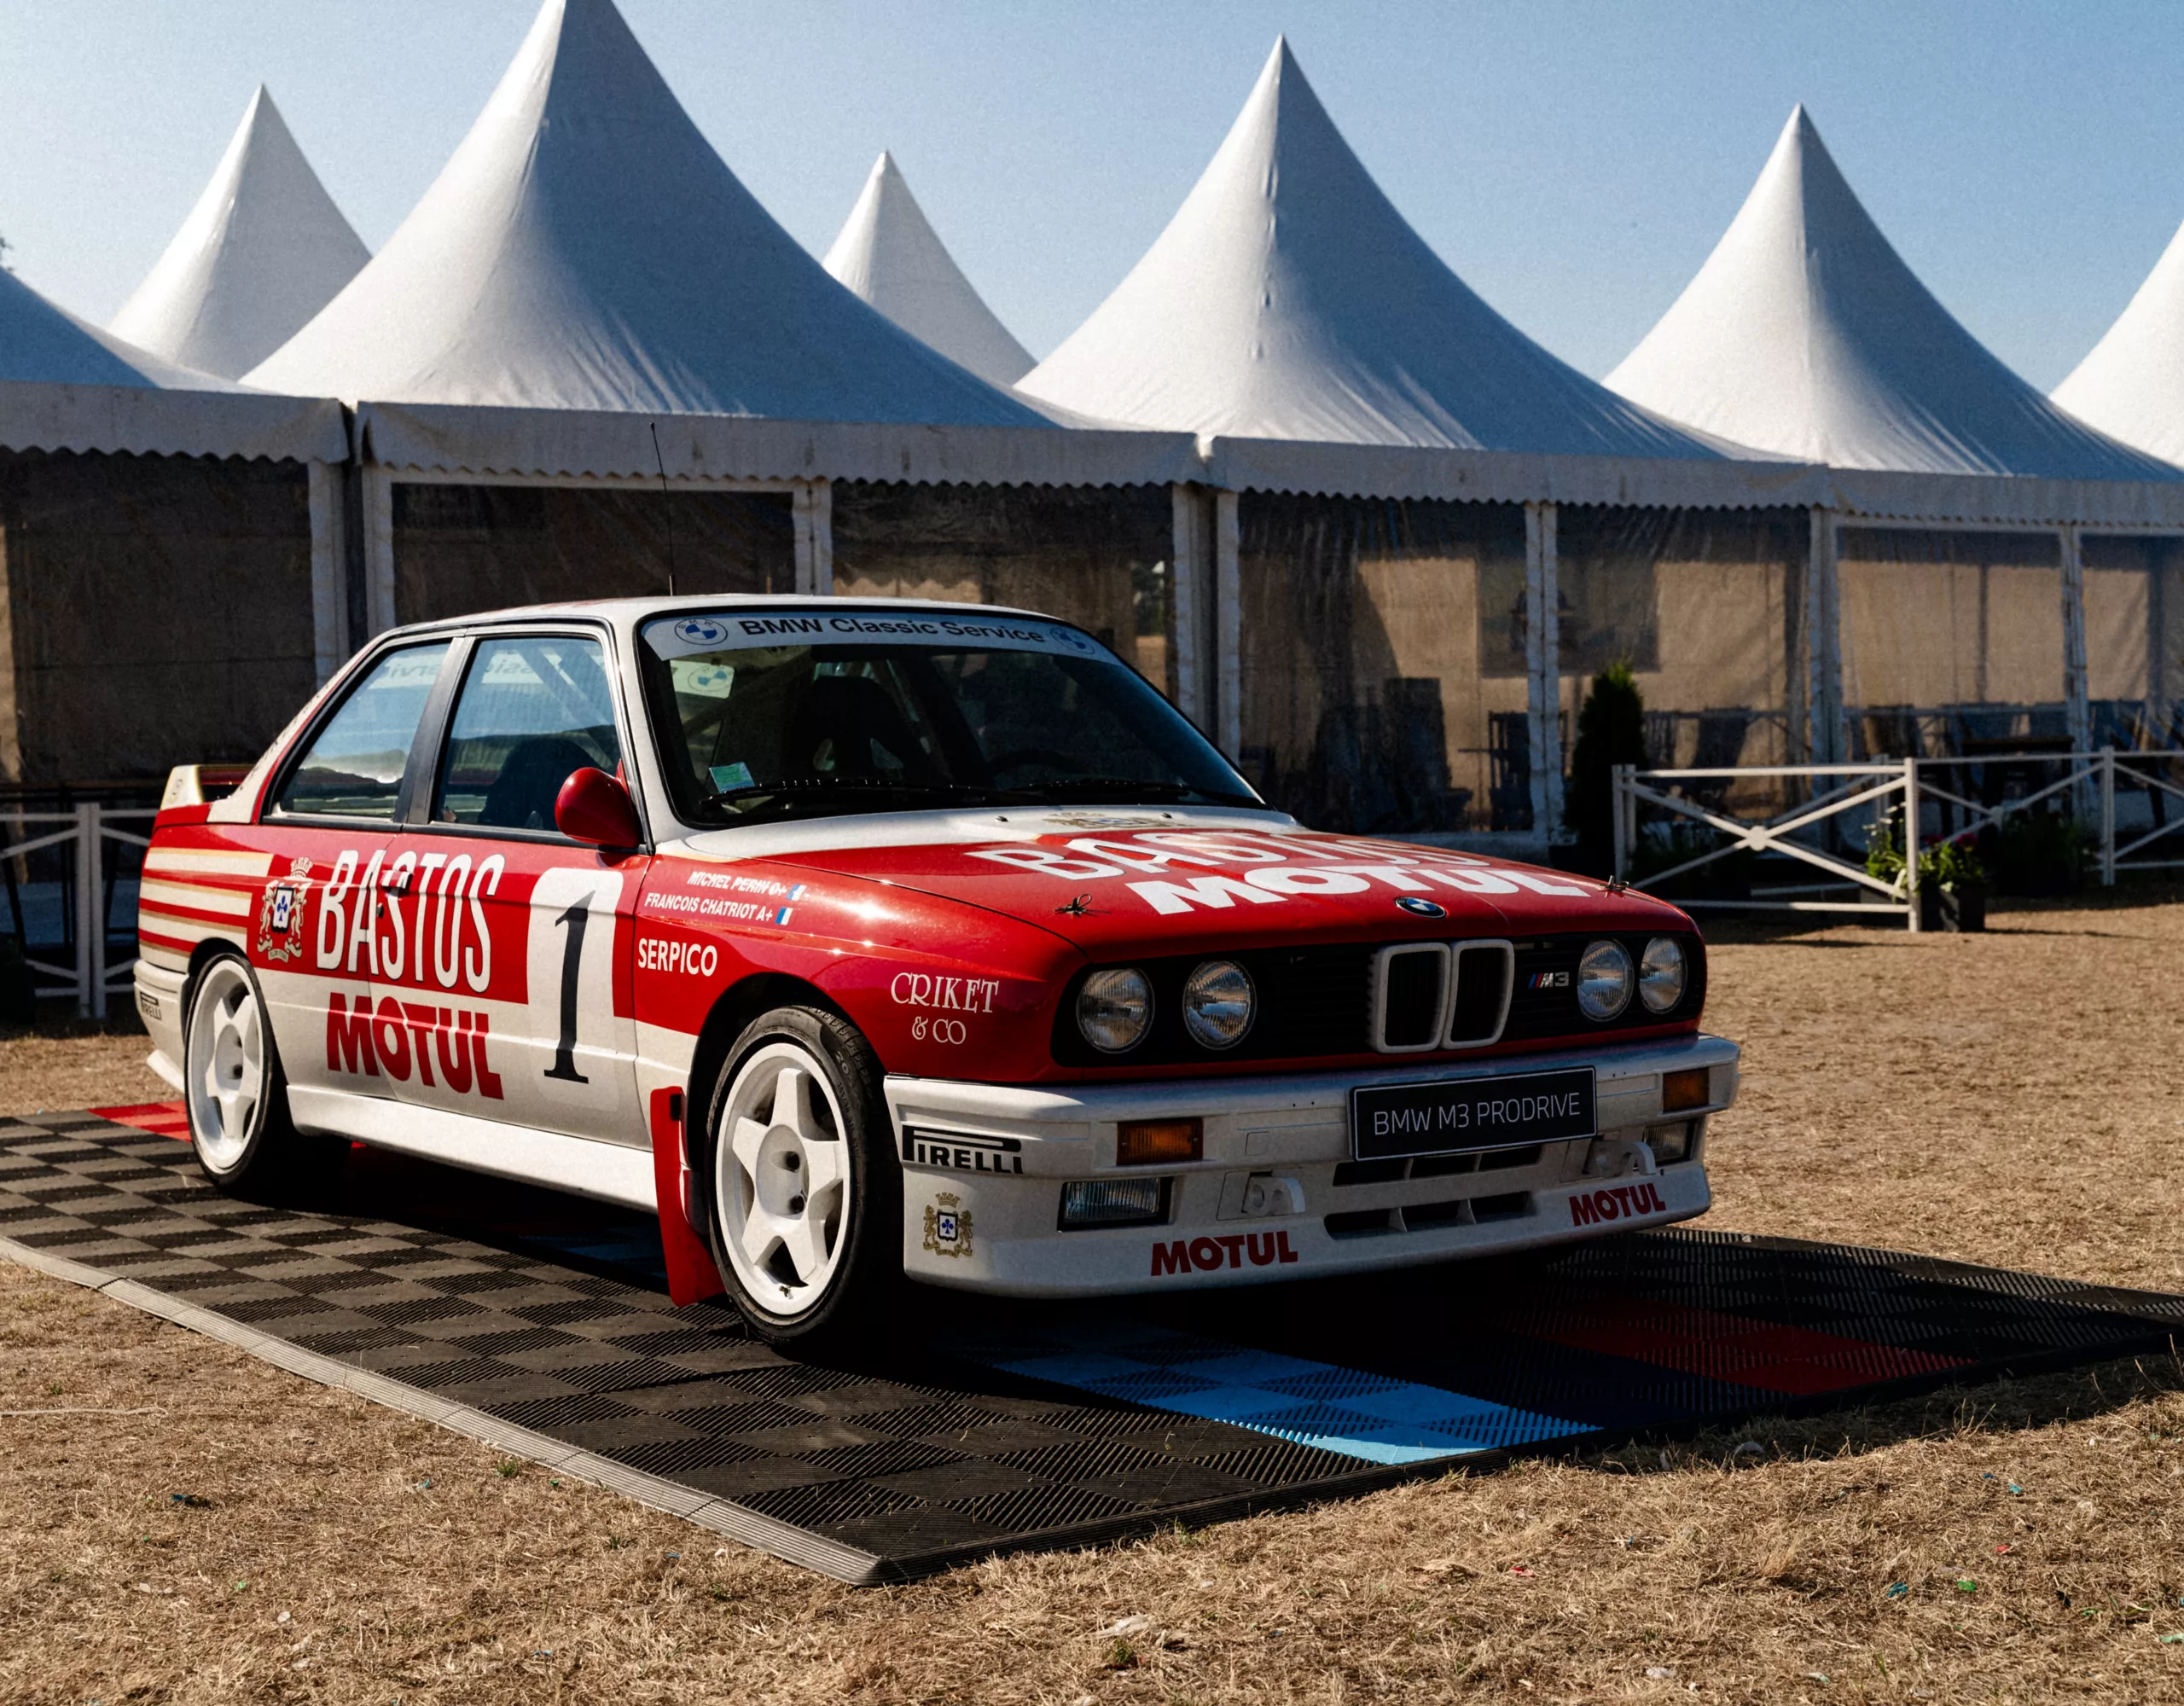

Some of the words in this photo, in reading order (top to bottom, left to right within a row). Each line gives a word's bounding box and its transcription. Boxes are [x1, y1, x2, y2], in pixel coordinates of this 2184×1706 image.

[739, 619, 823, 635] BMW
[829, 618, 938, 635] Classic
[940, 621, 1046, 642] Service
[962, 832, 1491, 880] BASTOS
[687, 871, 729, 889] MICHEL
[1125, 866, 1591, 915] MOTUL
[317, 849, 505, 993] BASTOS
[644, 892, 700, 913] FRANCOIS
[700, 898, 758, 920] CHATRIOT
[756, 906, 773, 921] A+
[638, 937, 717, 977] SERPICO
[140, 991, 162, 1020] PIRELLI
[544, 891, 595, 1084] 1
[891, 972, 999, 1013] CRIKET
[327, 991, 504, 1100] MOTUL
[911, 1016, 928, 1040] &
[932, 1018, 967, 1045] CO
[1374, 1107, 1432, 1135] BMW
[1438, 1104, 1469, 1129] M3
[1477, 1093, 1580, 1126] PRODRIVE
[903, 1125, 1024, 1174] PIRELLI
[1569, 1183, 1666, 1227] MOTUL
[1151, 1231, 1298, 1276] MOTUL
